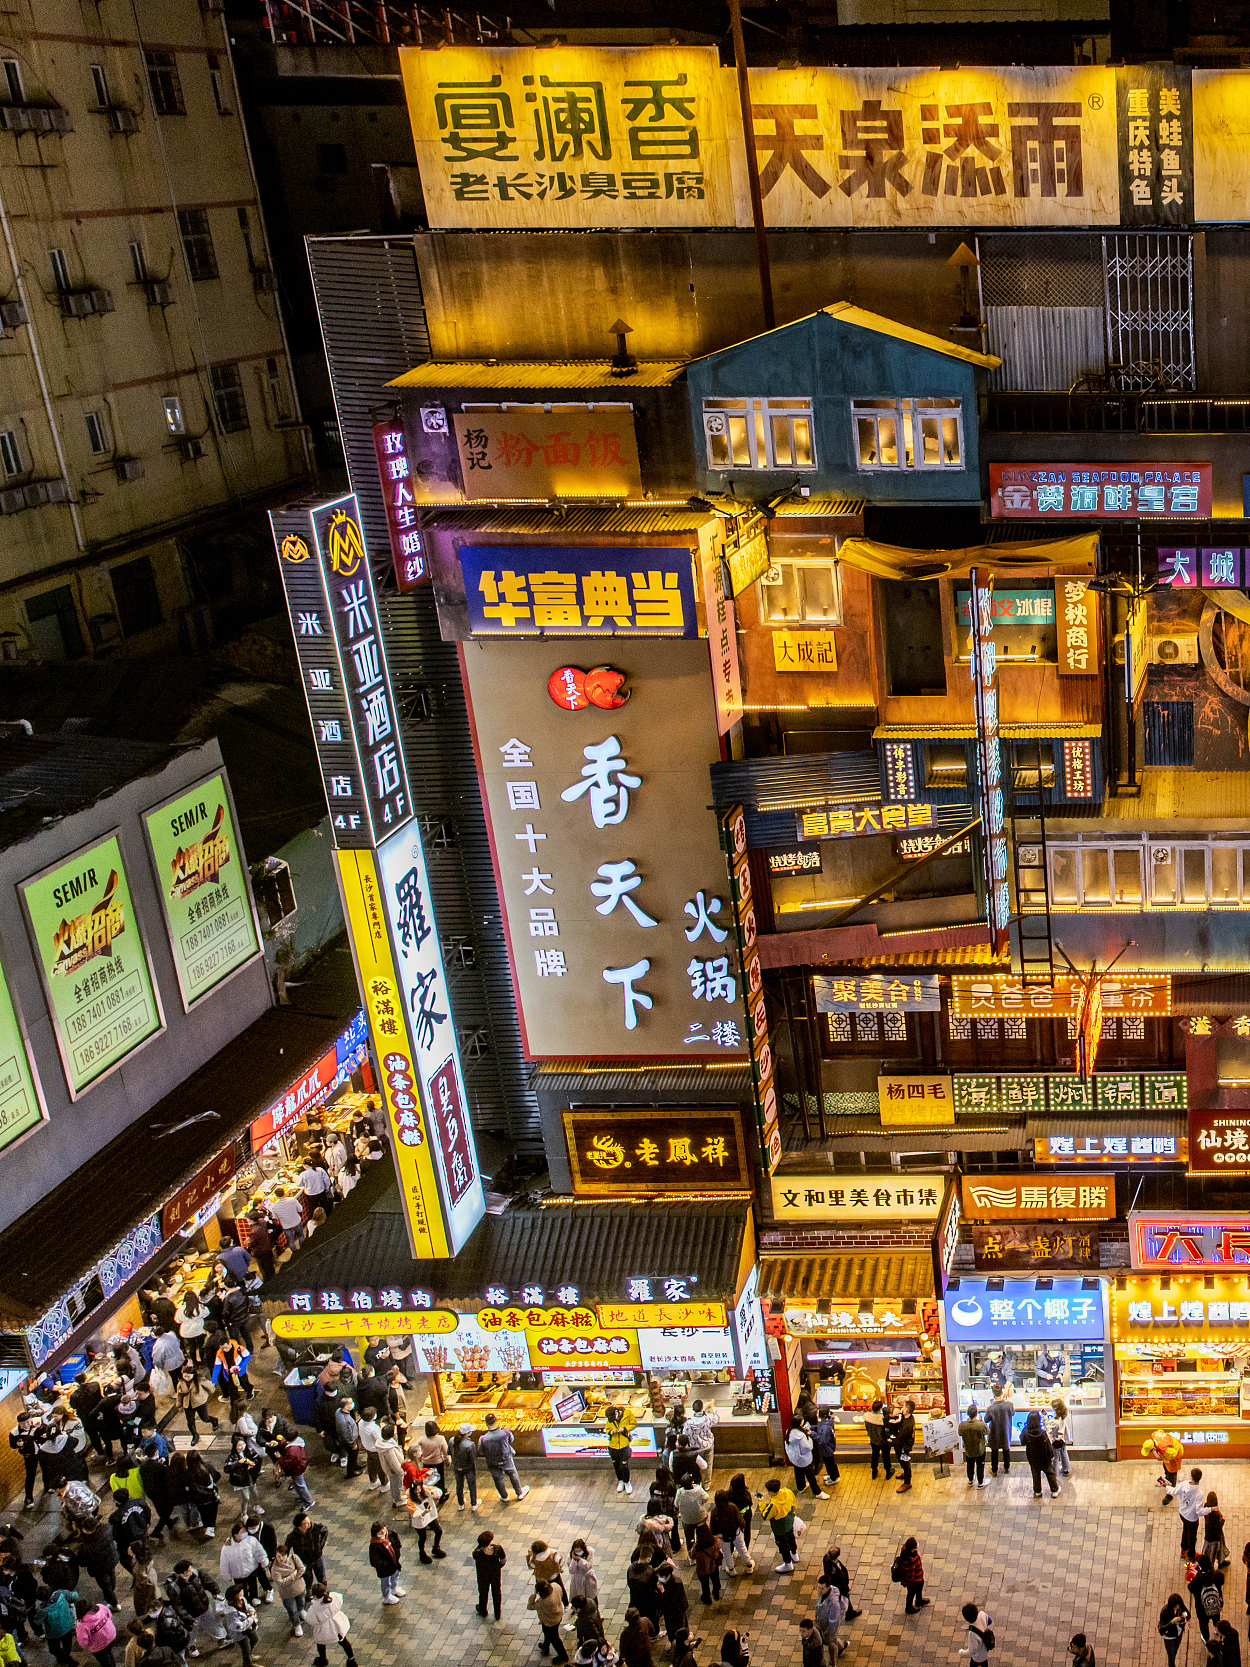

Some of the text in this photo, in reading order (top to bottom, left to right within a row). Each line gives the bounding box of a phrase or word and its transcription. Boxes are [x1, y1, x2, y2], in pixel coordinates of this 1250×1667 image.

[434, 72, 700, 162] 宴澜香
[753, 100, 1085, 200] 天泉添雨
[1127, 88, 1154, 207] 重庆特色
[1159, 87, 1184, 206] 美蛙鱼头
[450, 170, 706, 202] 老长沙臭豆腐
[462, 428, 494, 472] 杨记
[494, 430, 633, 469] 粉面饭
[1145, 471, 1201, 484] PALACE
[382, 431, 425, 582] 玫瑰人生婚纱
[479, 571, 685, 627] 华富典当
[1064, 581, 1090, 670] 梦秋商行
[777, 640, 834, 665] 大成記
[341, 579, 400, 800] 米亚酒店
[298, 612, 361, 830] 米亚酒店 4F
[500, 738, 568, 978] 全国十大品牌
[188, 883, 231, 923] 全省招商热线
[561, 736, 660, 1031] 香天下
[684, 890, 738, 1004] 火锅
[73, 955, 126, 1004] 全省招商热线
[71, 1014, 87, 1034] 188
[106, 988, 126, 1013] 0881
[113, 1017, 133, 1041] 7168
[684, 1019, 741, 1048] 二楼
[886, 1083, 946, 1100] 杨四毛
[634, 1137, 730, 1168] 老鳳祥
[1020, 1186, 1107, 1208] 馬復勝
[982, 1236, 1077, 1260] 点一盏灯
[804, 1311, 904, 1328] 仙境豆夫
[990, 1298, 1097, 1320] 整个椰子
